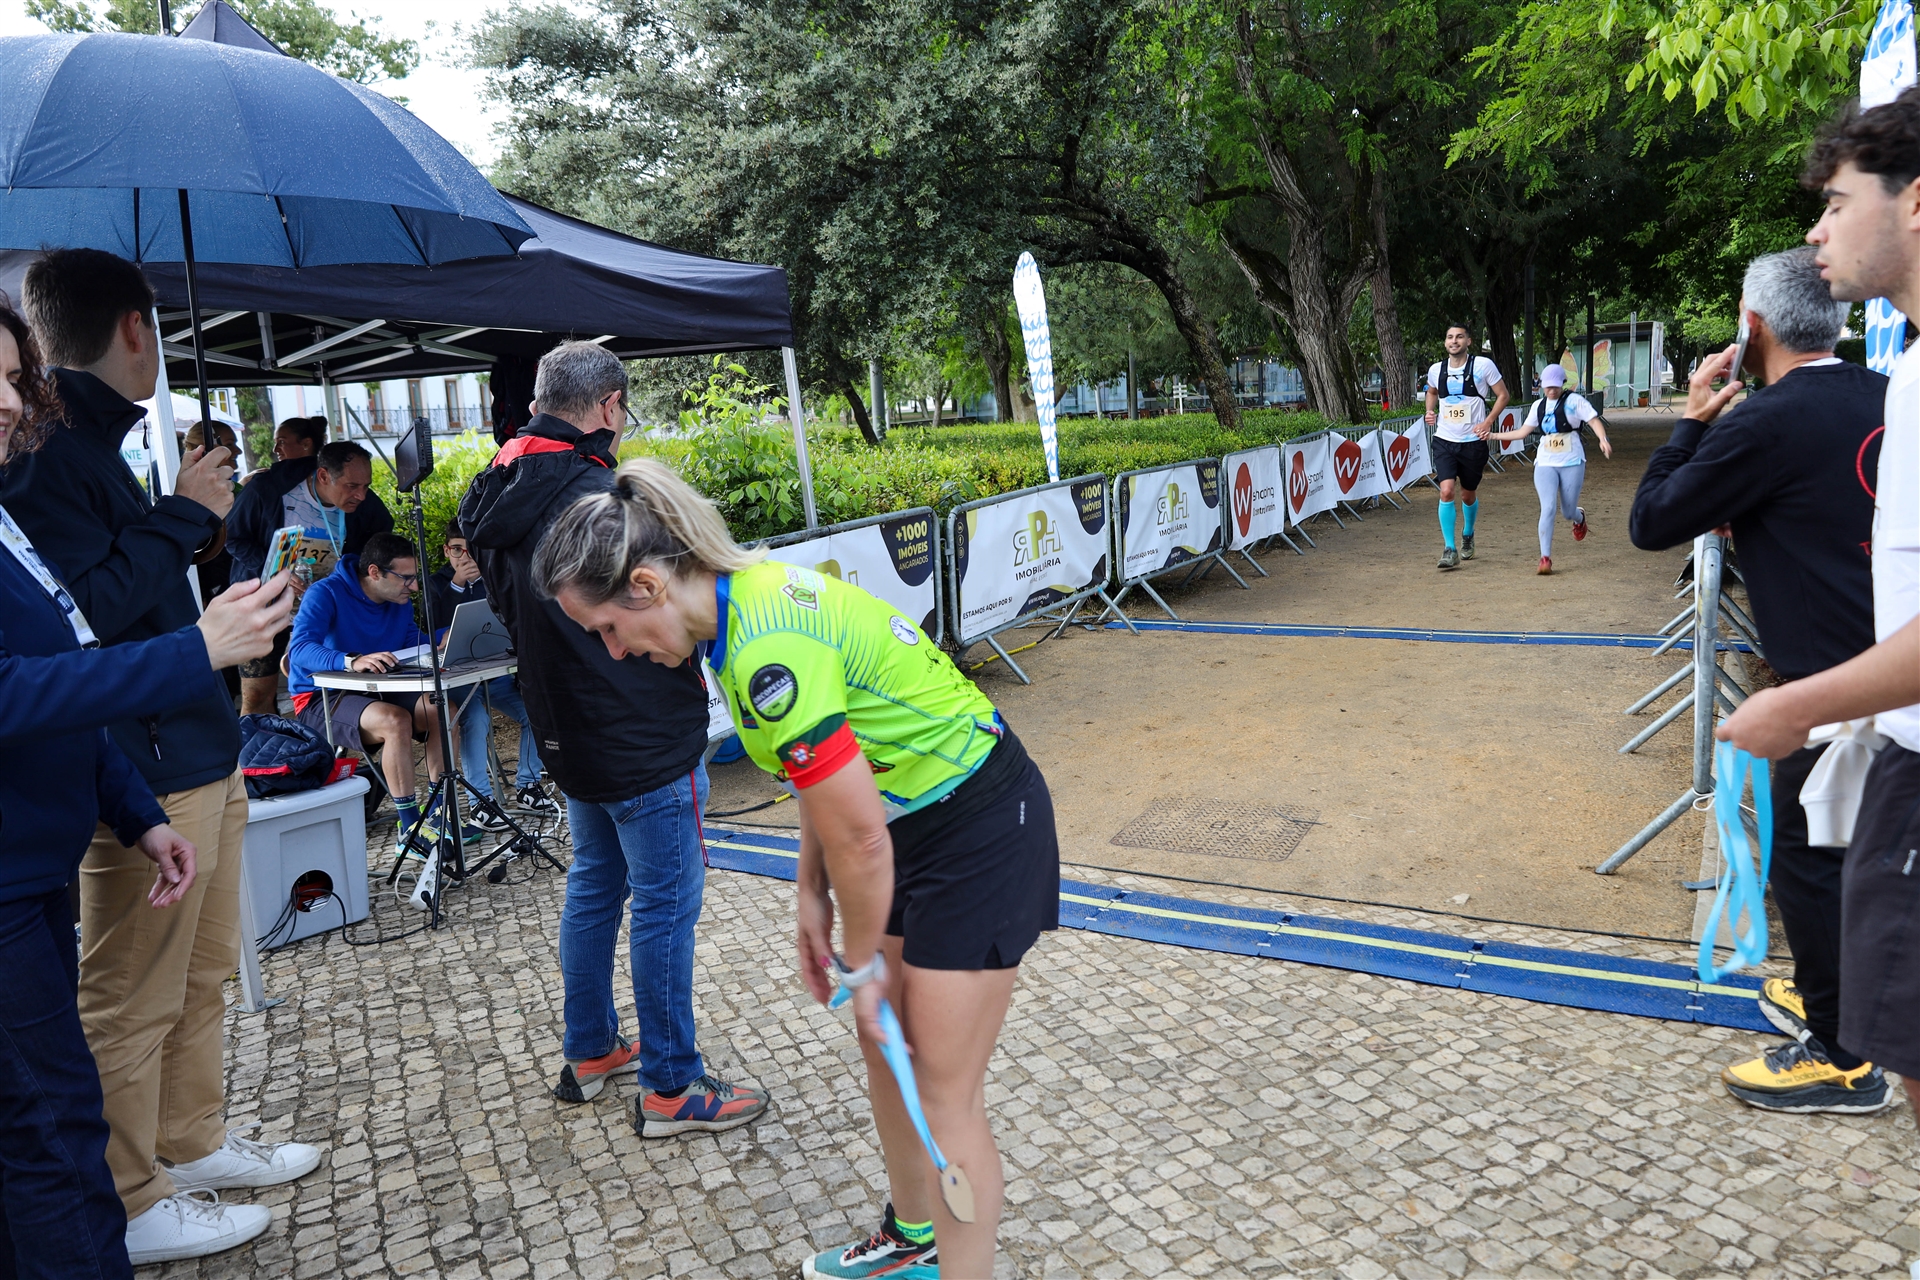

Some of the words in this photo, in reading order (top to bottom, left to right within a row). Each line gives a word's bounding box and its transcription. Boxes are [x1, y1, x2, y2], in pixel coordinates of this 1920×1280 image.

[1448, 410, 1465, 418] 195
[1548, 439, 1564, 448] 194
[1335, 456, 1360, 479] W
[1080, 483, 1102, 500] +1000
[1235, 485, 1251, 517] W
[896, 520, 928, 542] +1000
[299, 547, 331, 563] 137
[897, 541, 928, 560] IMÓVEIS
[898, 554, 929, 571] ANGARIADOS
[1015, 556, 1062, 581] IMOBILIÁRIA
[962, 607, 986, 620] ESTAMOS
[985, 602, 998, 611] AQUI
[998, 599, 1008, 607] POR
